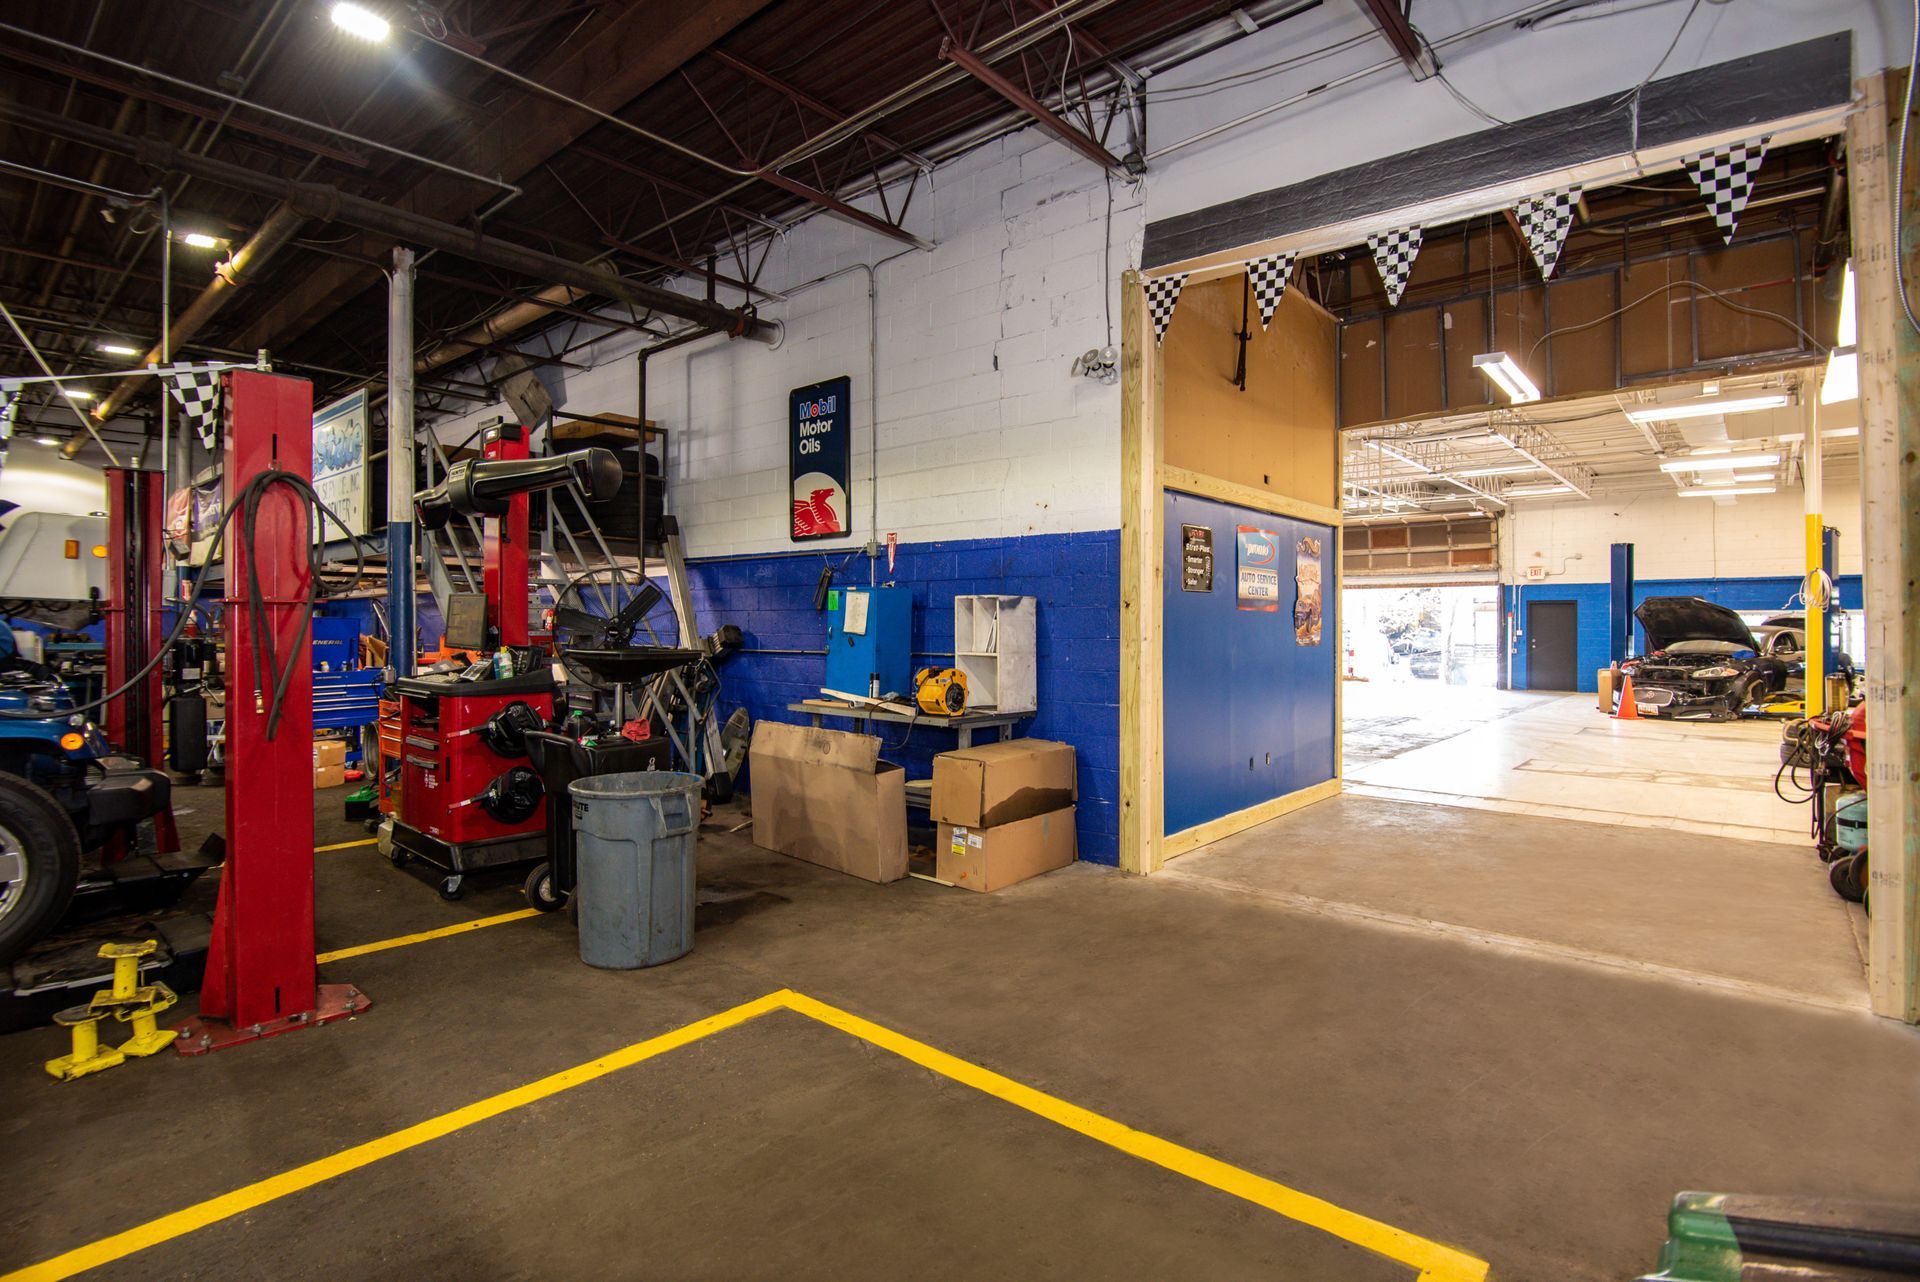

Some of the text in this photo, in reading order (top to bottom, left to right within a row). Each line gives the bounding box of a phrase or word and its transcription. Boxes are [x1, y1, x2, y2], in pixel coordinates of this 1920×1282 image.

[799, 395, 836, 420] Mobil
[799, 418, 833, 438] Motor
[799, 438, 821, 455] Oils
[1241, 572, 1277, 586] AUTO SERVICE
[1530, 568, 1542, 577] EXIT
[1248, 585, 1269, 597] CENTER
